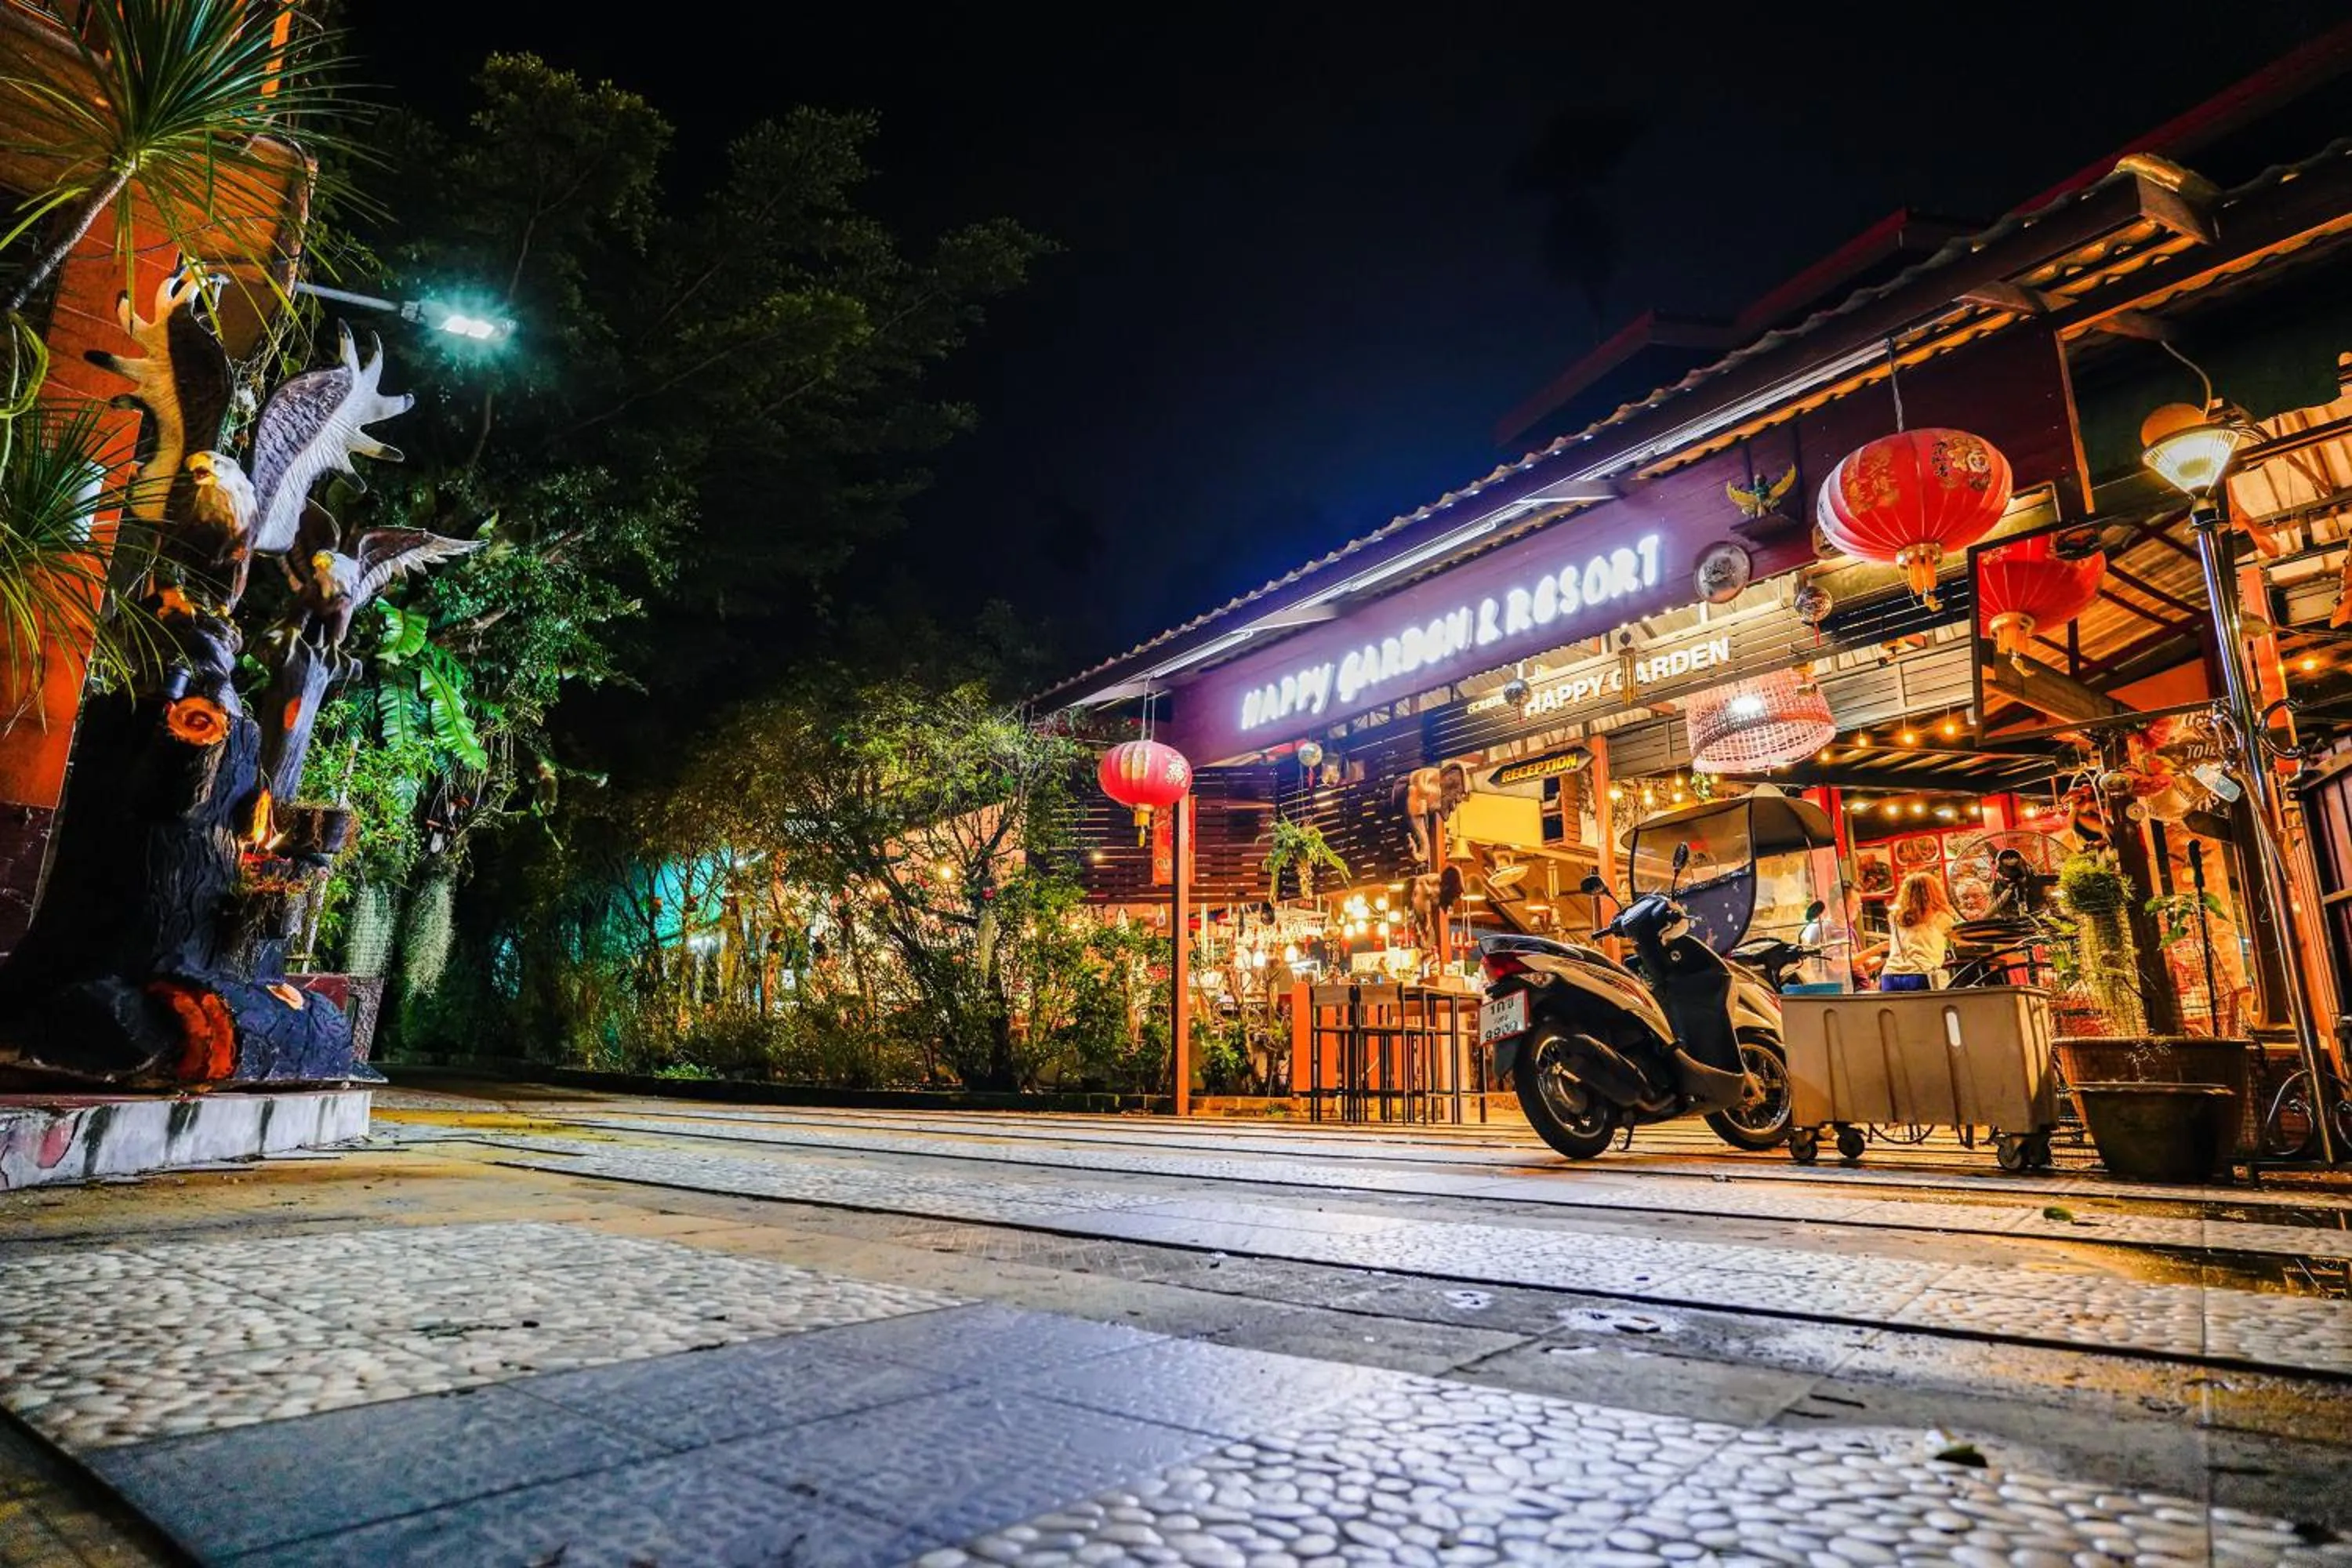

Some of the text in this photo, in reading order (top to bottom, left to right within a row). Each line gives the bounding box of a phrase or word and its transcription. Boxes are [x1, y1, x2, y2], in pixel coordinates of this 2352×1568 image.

[1241, 534, 1659, 730] HAPPY GARDEN & RESORT
[1525, 673, 1606, 717] HAPPY
[1501, 753, 1577, 783] RECEPTION
